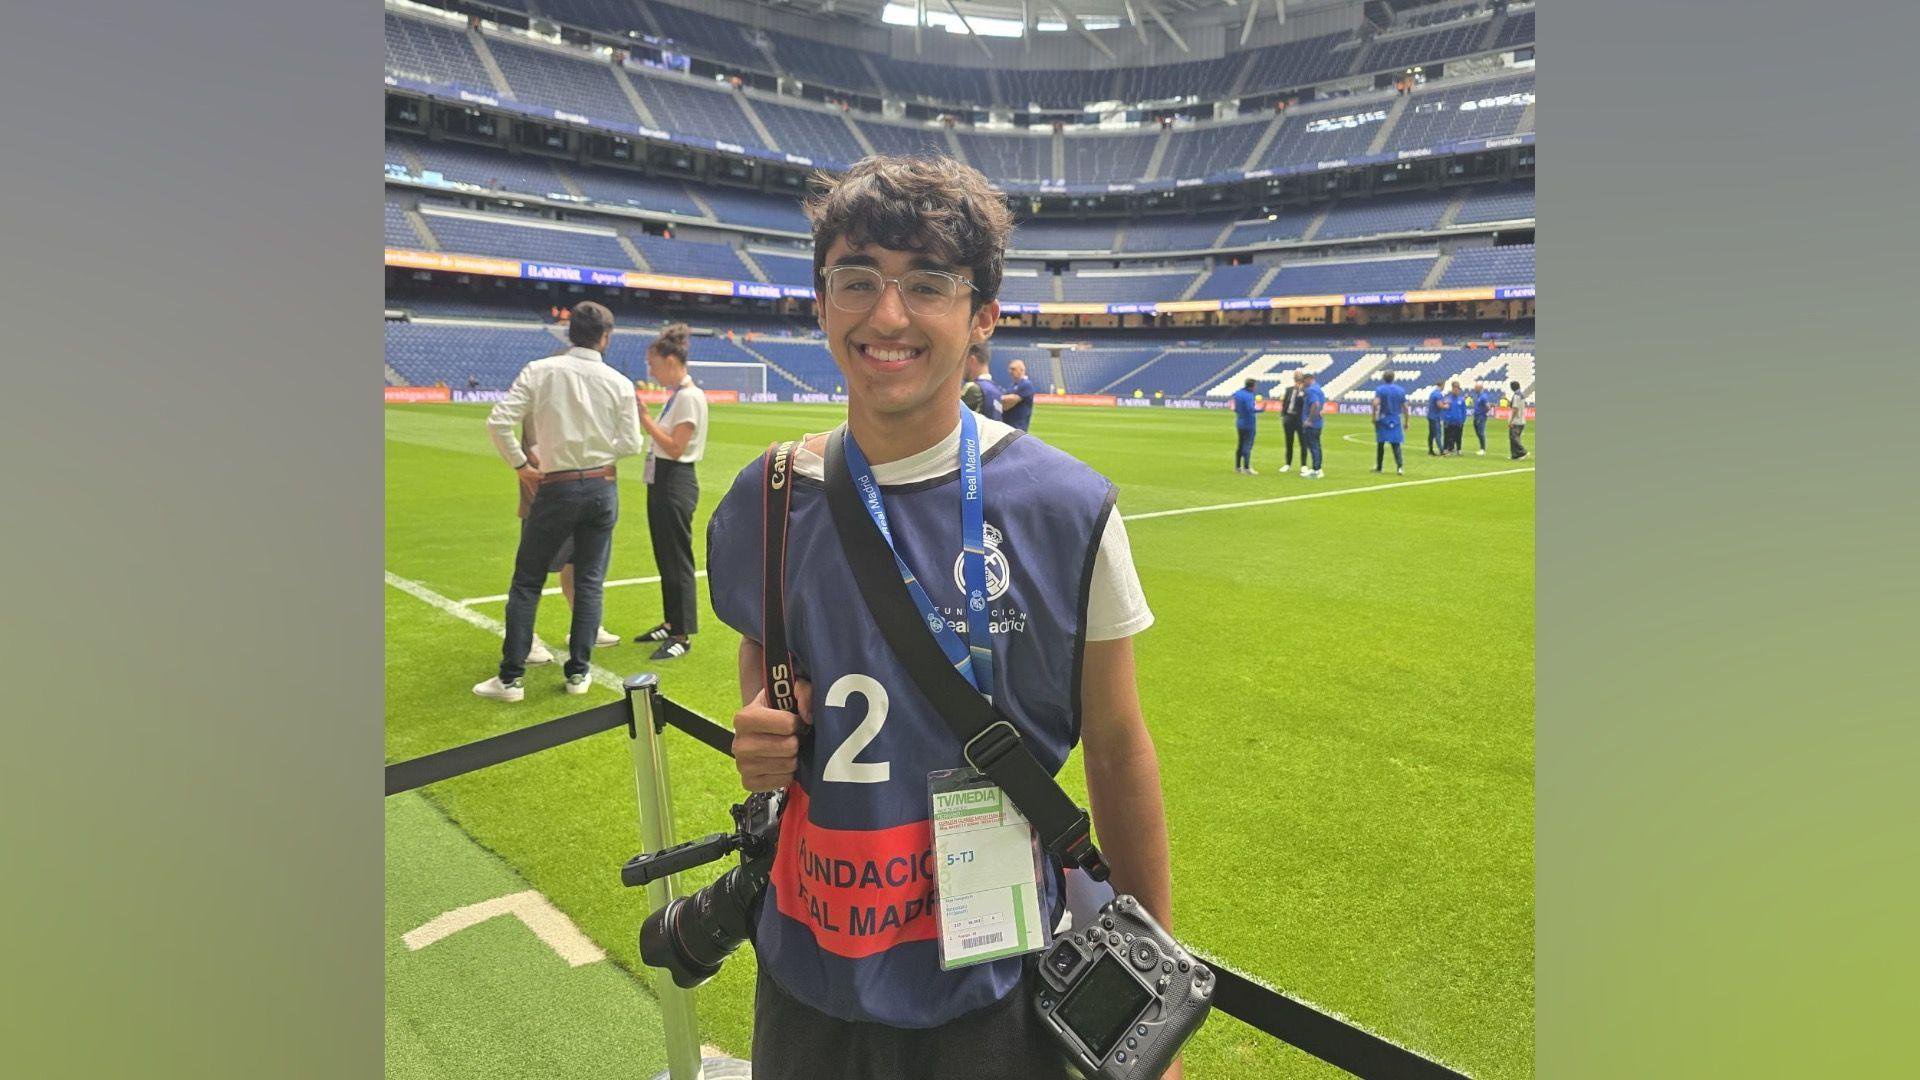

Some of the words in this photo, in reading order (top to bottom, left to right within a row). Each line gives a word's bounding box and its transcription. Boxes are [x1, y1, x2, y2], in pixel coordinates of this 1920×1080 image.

[965, 439, 976, 474] Madrid
[858, 474, 881, 509] Madrid
[966, 478, 977, 500] Real
[941, 616, 969, 633] eal
[989, 617, 1025, 633] adrid
[772, 664, 793, 710] EOS
[823, 673, 890, 783] 2
[936, 789, 996, 808] TV/MEDIA
[946, 850, 974, 866] 5-TJ
[849, 889, 936, 936] MADR
